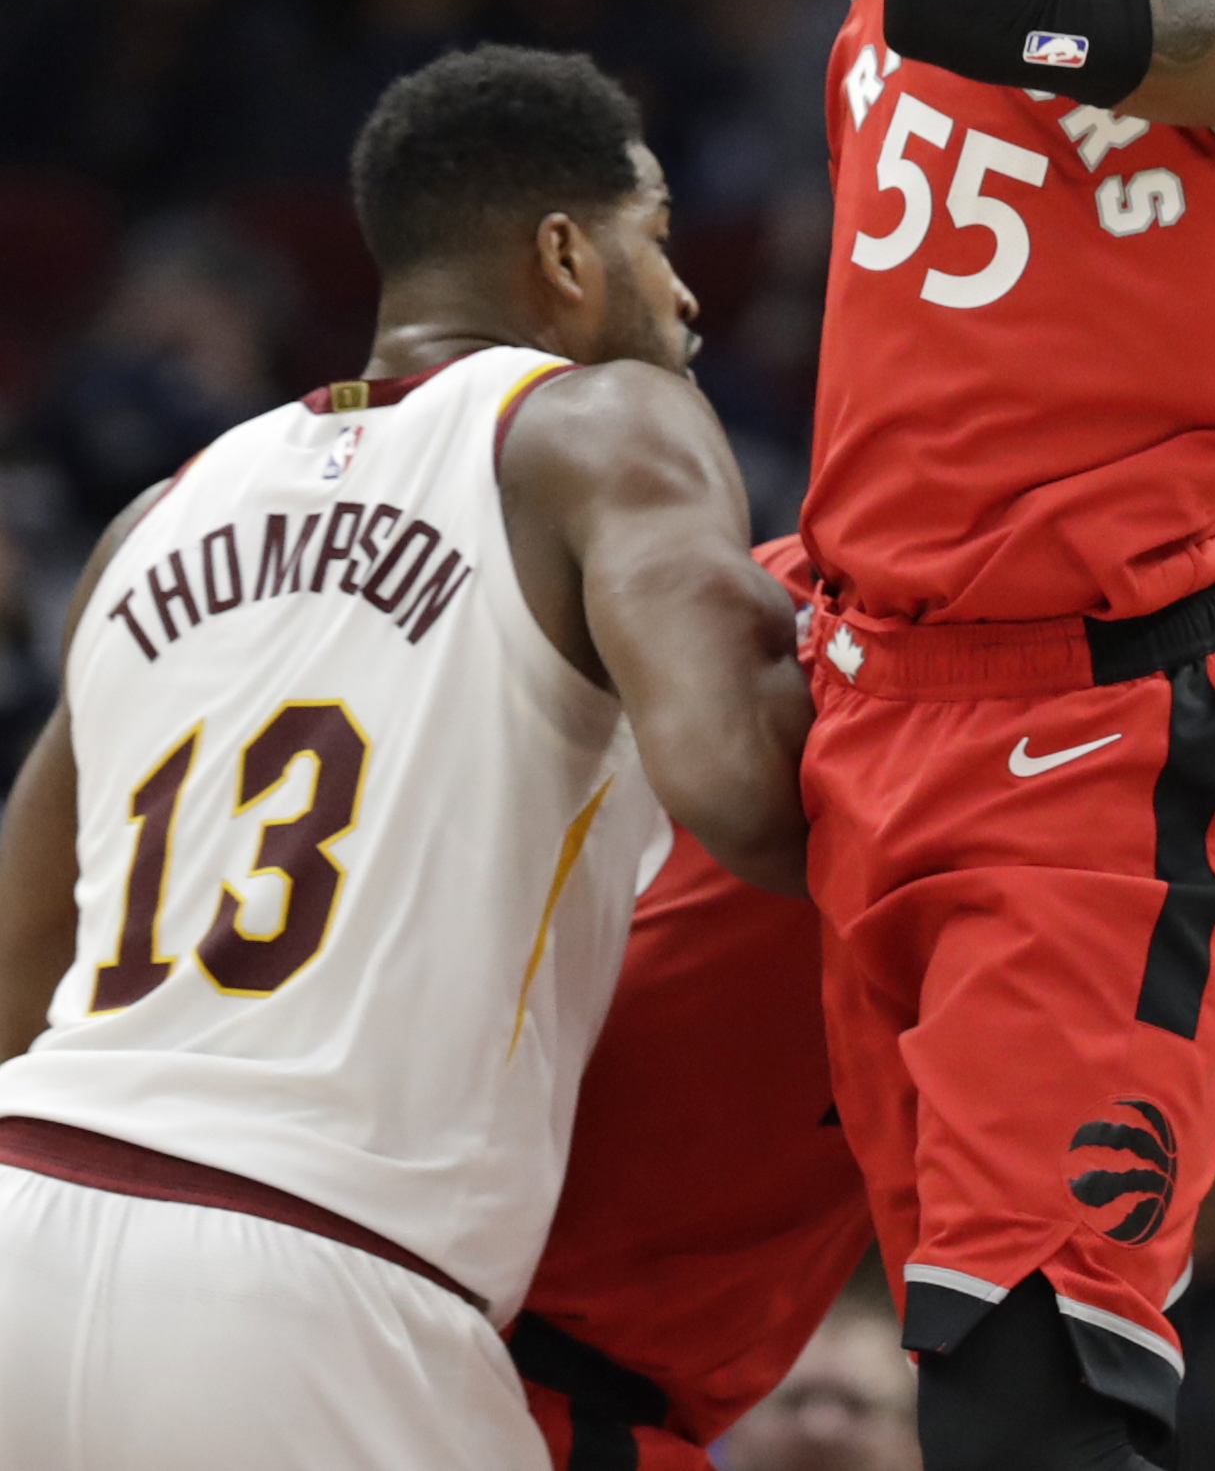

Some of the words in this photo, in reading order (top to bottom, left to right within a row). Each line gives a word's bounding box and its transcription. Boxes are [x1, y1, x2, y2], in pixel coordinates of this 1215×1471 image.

[850, 91, 1050, 310] 55
[108, 501, 473, 663] THOMPSON
[84, 698, 372, 1017] 13
